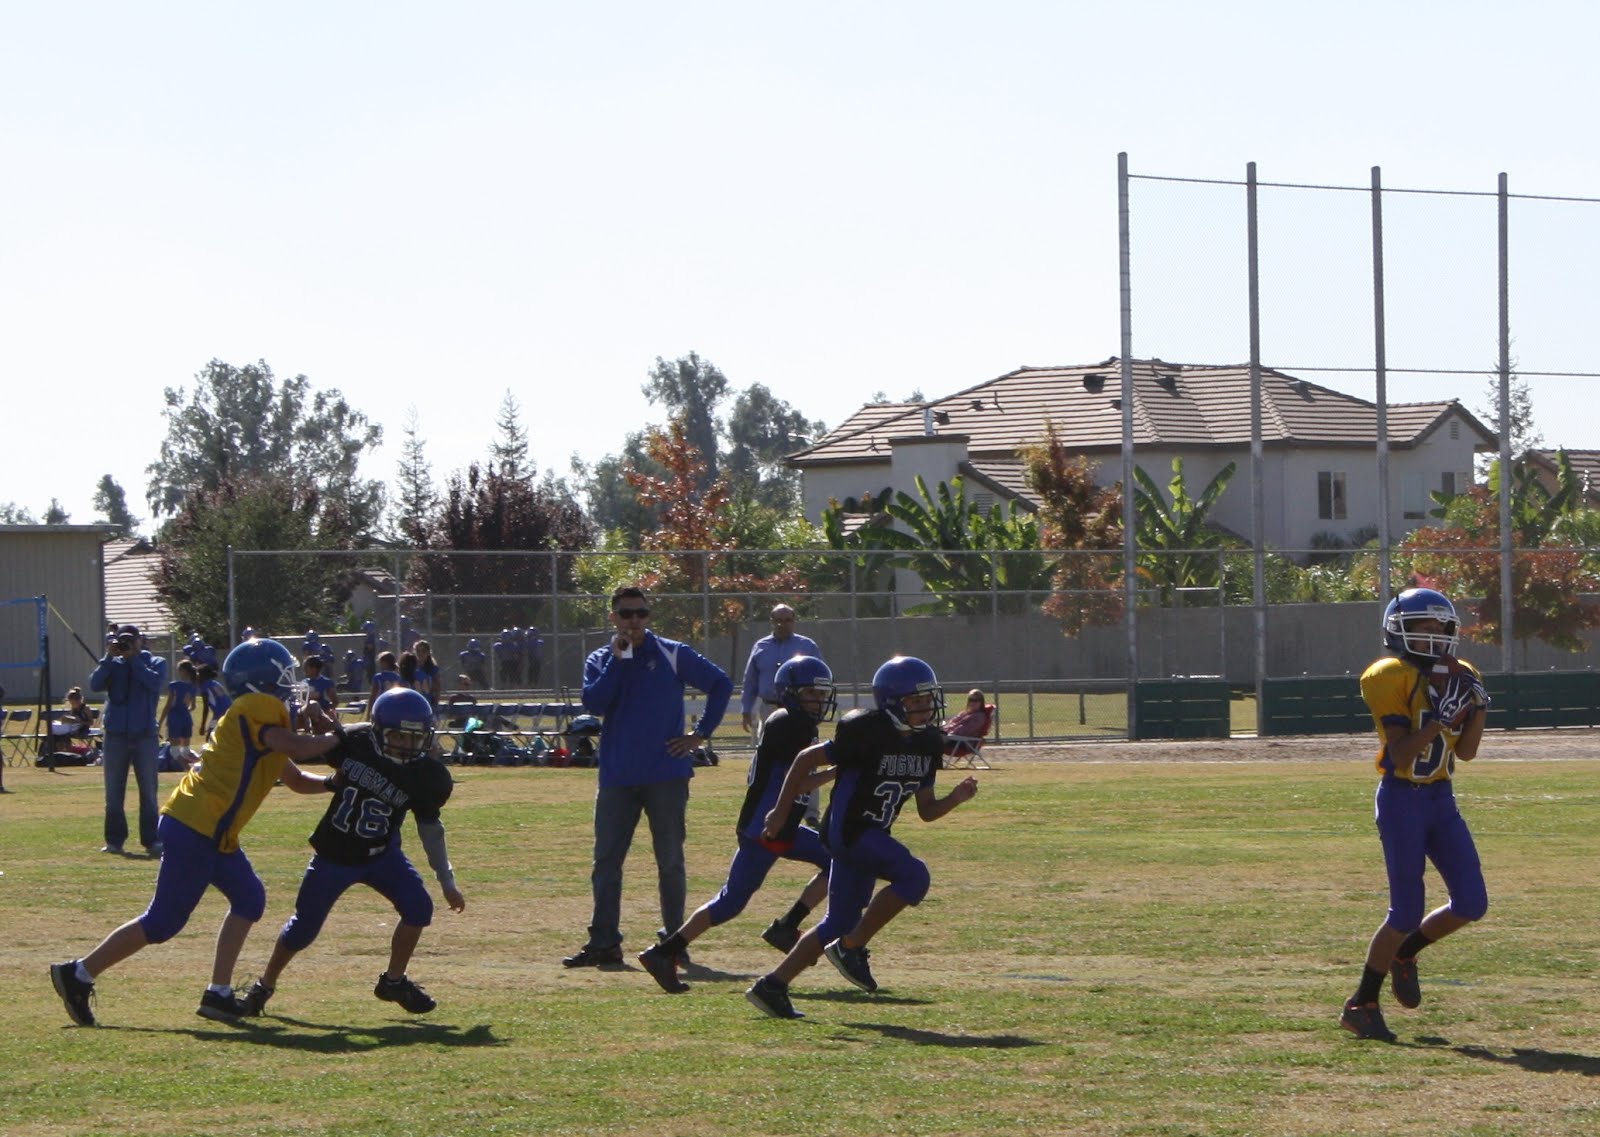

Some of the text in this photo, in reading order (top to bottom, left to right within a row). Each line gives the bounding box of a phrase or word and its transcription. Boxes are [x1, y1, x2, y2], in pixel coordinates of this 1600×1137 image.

[341, 758, 409, 807] FUGMAN
[876, 754, 932, 777] FUGMAN
[331, 786, 393, 838] 16
